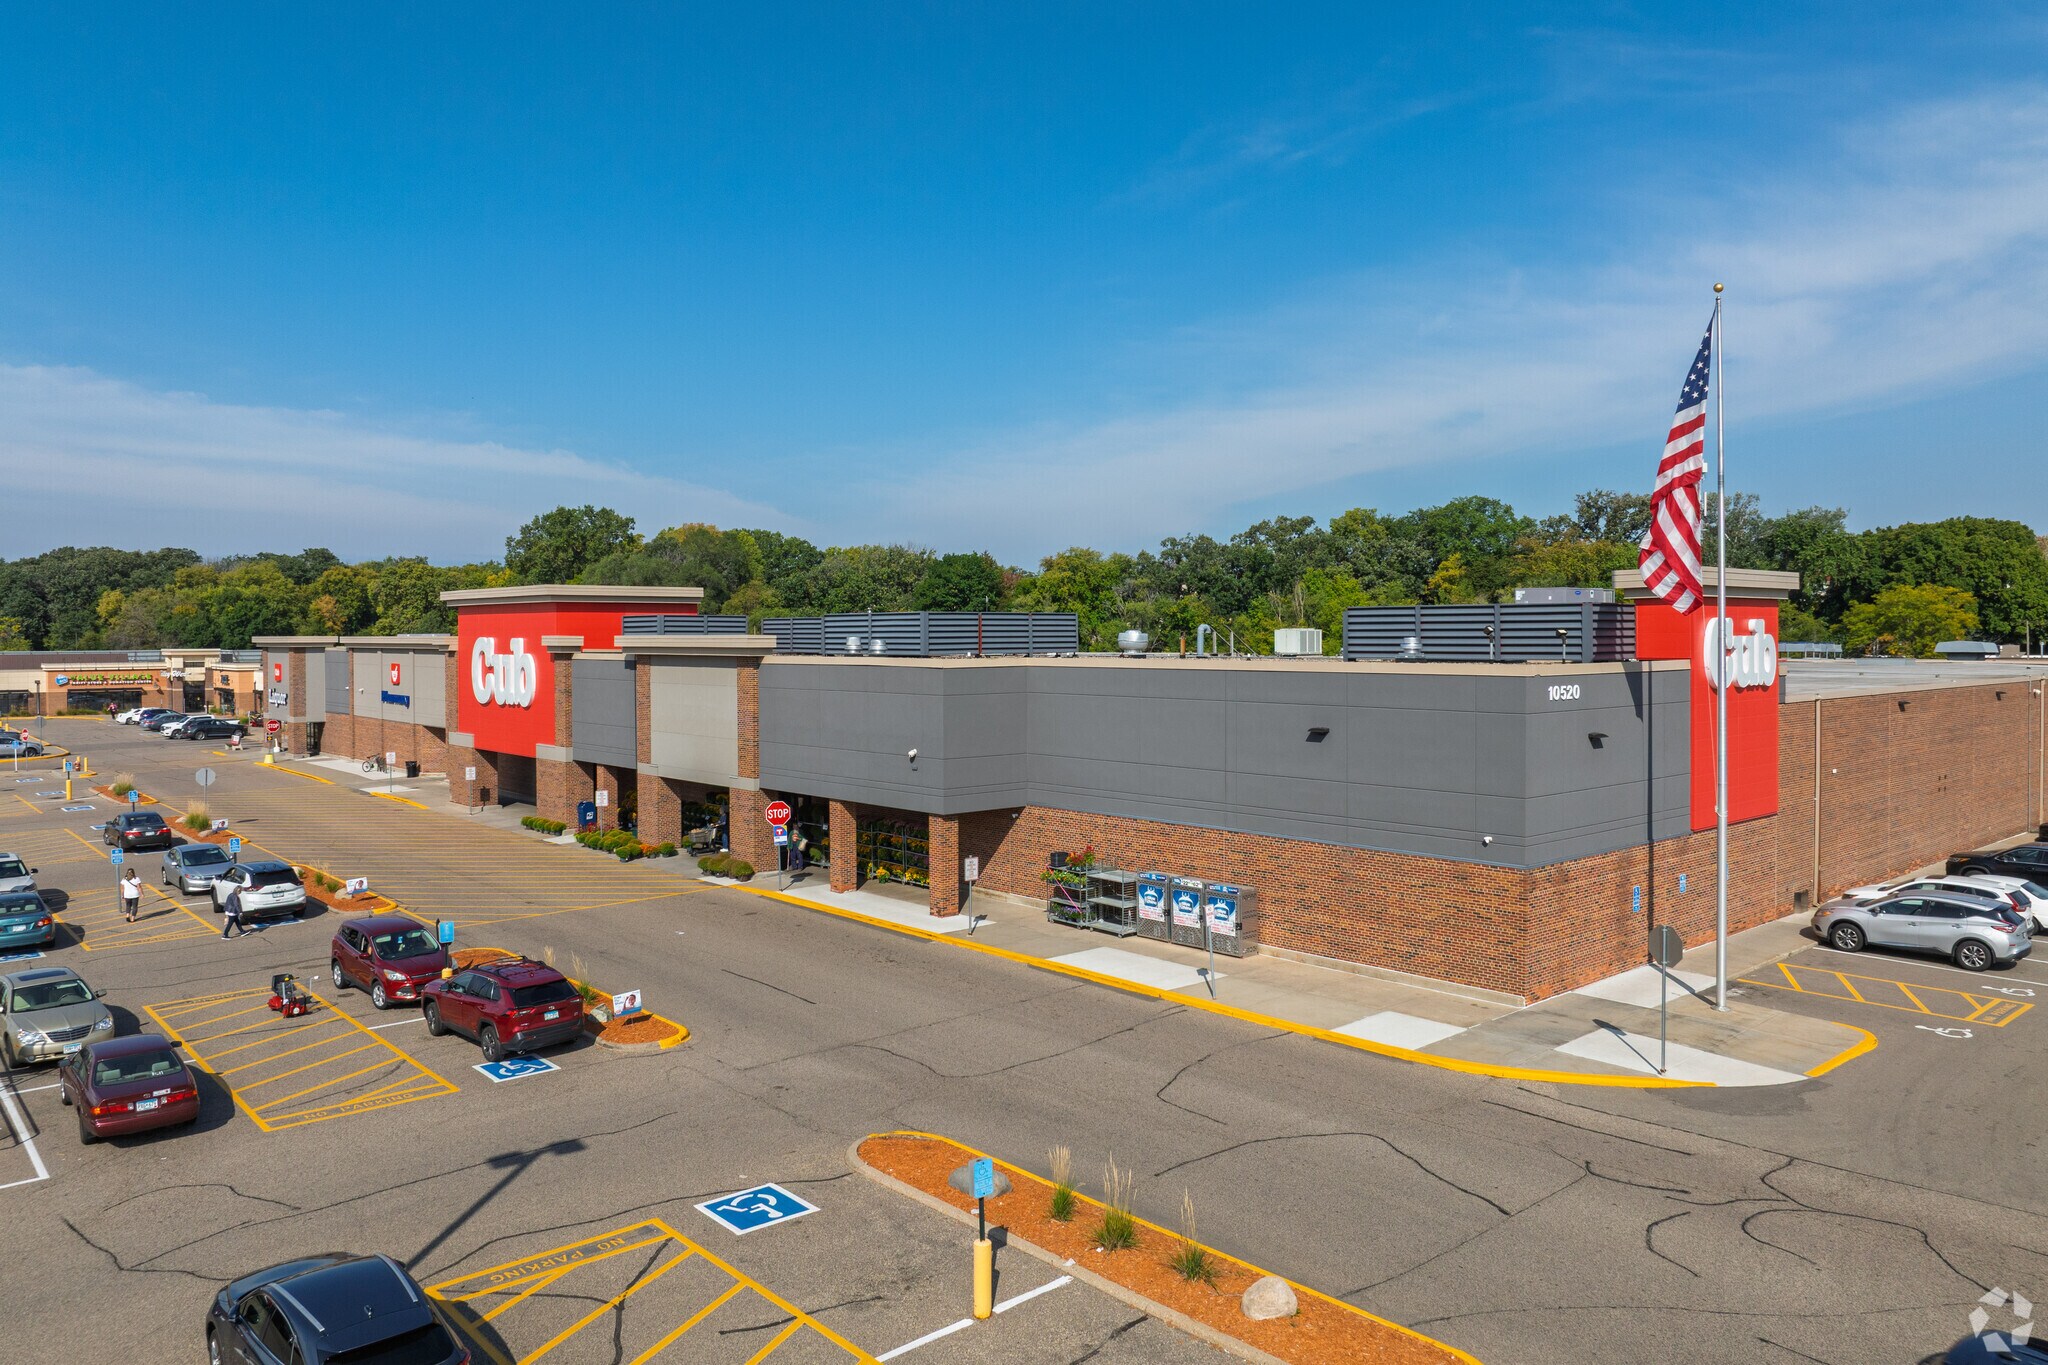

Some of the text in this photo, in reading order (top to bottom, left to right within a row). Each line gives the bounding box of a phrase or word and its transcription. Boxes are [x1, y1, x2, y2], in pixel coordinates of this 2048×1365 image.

[1704, 617, 1776, 687] Cub
[471, 636, 536, 707] Cub
[1548, 685, 1580, 701] 10520
[768, 809, 788, 818] STOP
[340, 1093, 414, 1112] PARKING
[490, 1237, 626, 1283] NO PARKING
